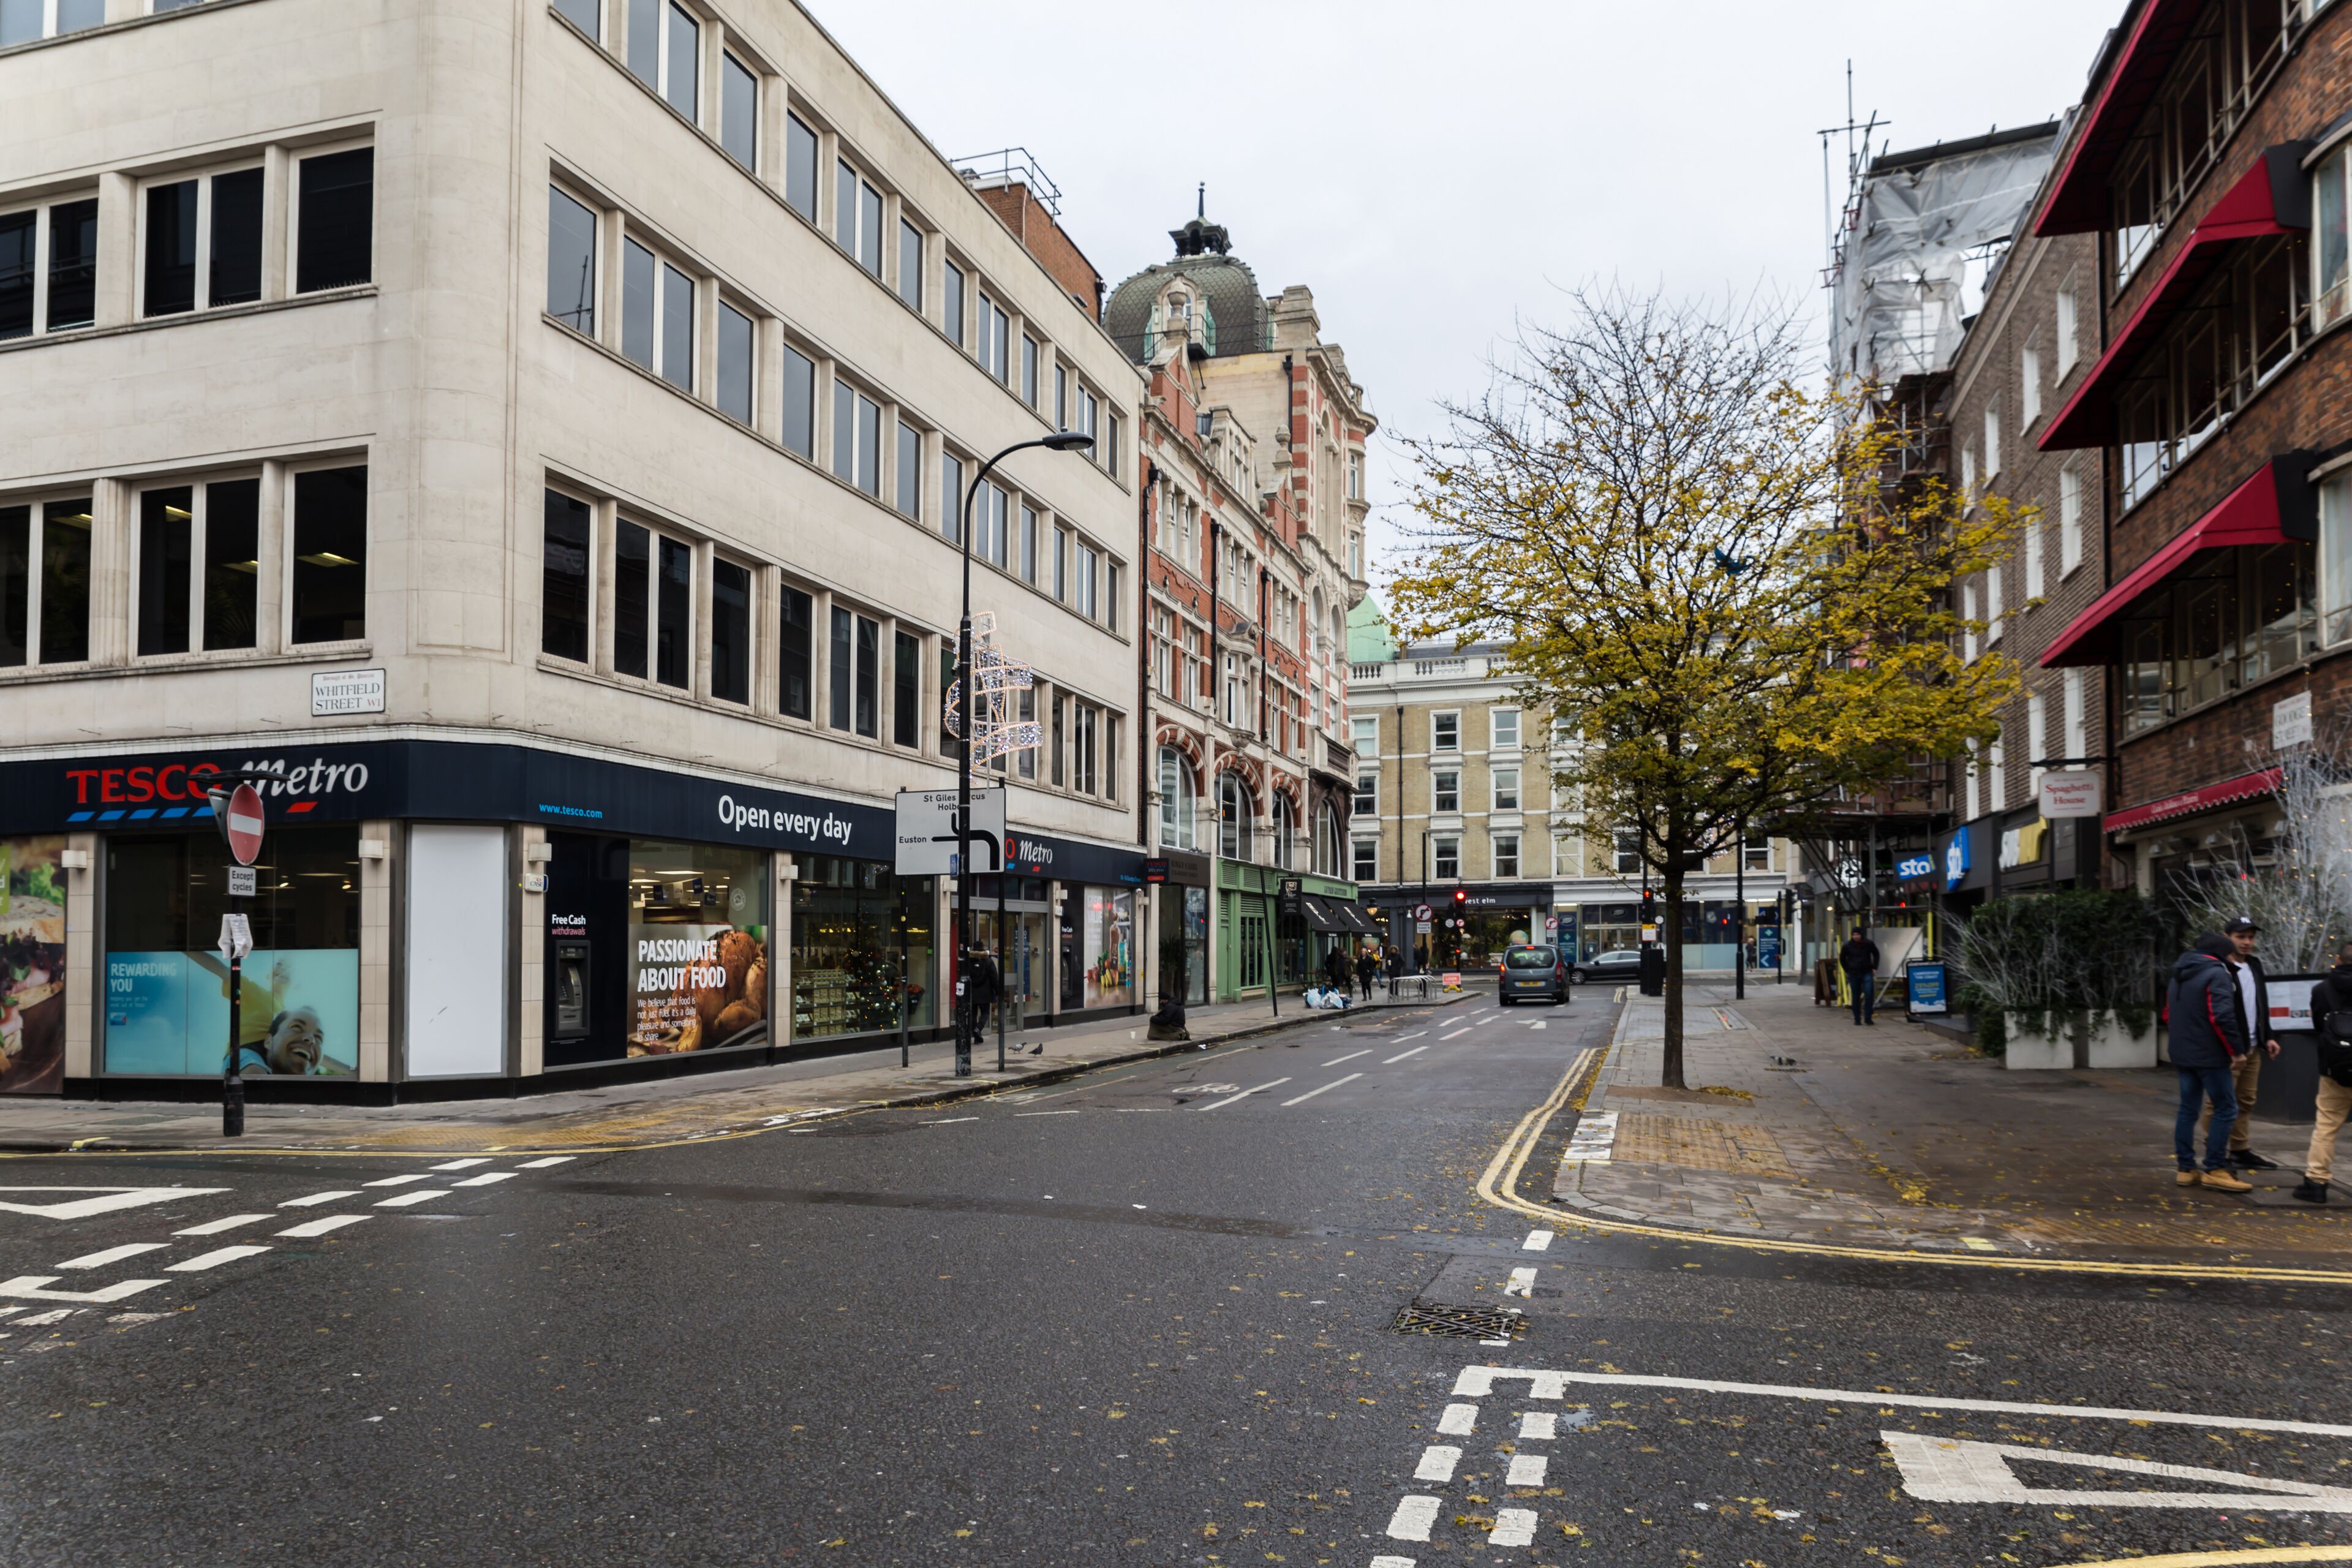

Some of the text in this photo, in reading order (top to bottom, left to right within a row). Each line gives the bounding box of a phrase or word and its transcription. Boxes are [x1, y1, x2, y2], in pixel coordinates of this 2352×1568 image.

[315, 682, 380, 697] WHITFIELD
[315, 697, 363, 711] STREET
[66, 758, 368, 803] TESCO Metro
[2045, 783, 2095, 794] Spaghetti
[2053, 796, 2086, 805] House
[539, 804, 603, 819] www.tesco.com
[718, 795, 852, 845] Open every day
[1019, 840, 1053, 864] Metro
[232, 870, 254, 881] Except
[232, 883, 252, 892] cycles
[551, 914, 586, 925] Free Cash
[551, 927, 586, 935] withdrawals
[638, 939, 717, 962] PASSIONATE
[111, 963, 177, 977] REWARDING
[110, 978, 133, 992] YOU
[637, 966, 726, 992] ABOUT FOOD
[638, 999, 646, 1008] We
[647, 997, 666, 1006] believe
[668, 996, 677, 1006] that
[679, 996, 690, 1005] food
[637, 1010, 646, 1019] not
[647, 1009, 657, 1020] just
[685, 1008, 696, 1017] daily
[637, 1017, 696, 1031] pleasure and something
[637, 1031, 659, 1042] to share
